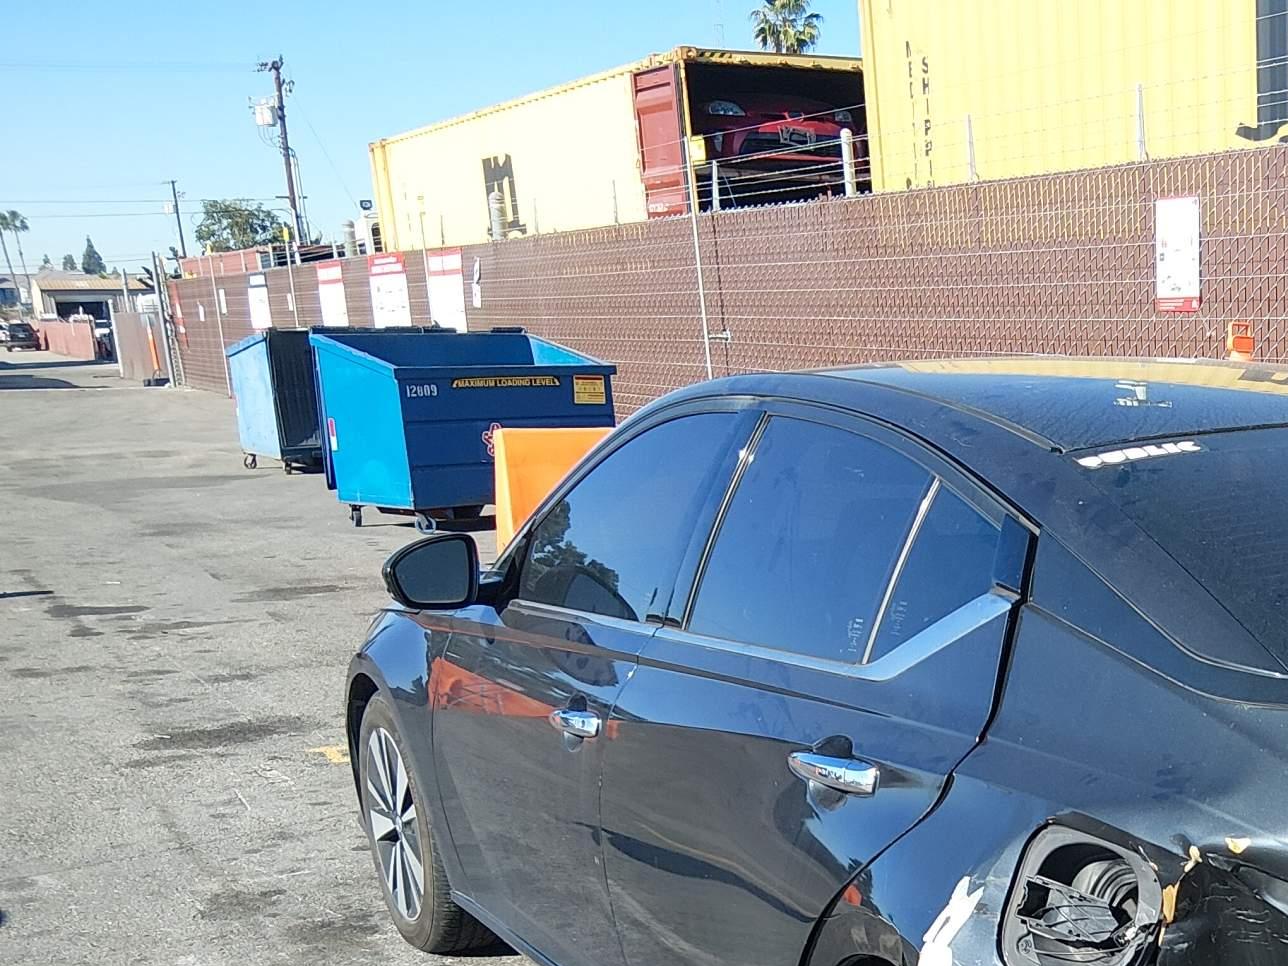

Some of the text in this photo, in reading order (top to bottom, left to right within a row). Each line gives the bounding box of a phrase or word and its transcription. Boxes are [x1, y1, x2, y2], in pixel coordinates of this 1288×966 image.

[457, 377, 555, 388] MAXIMUM LOADING LEVEL
